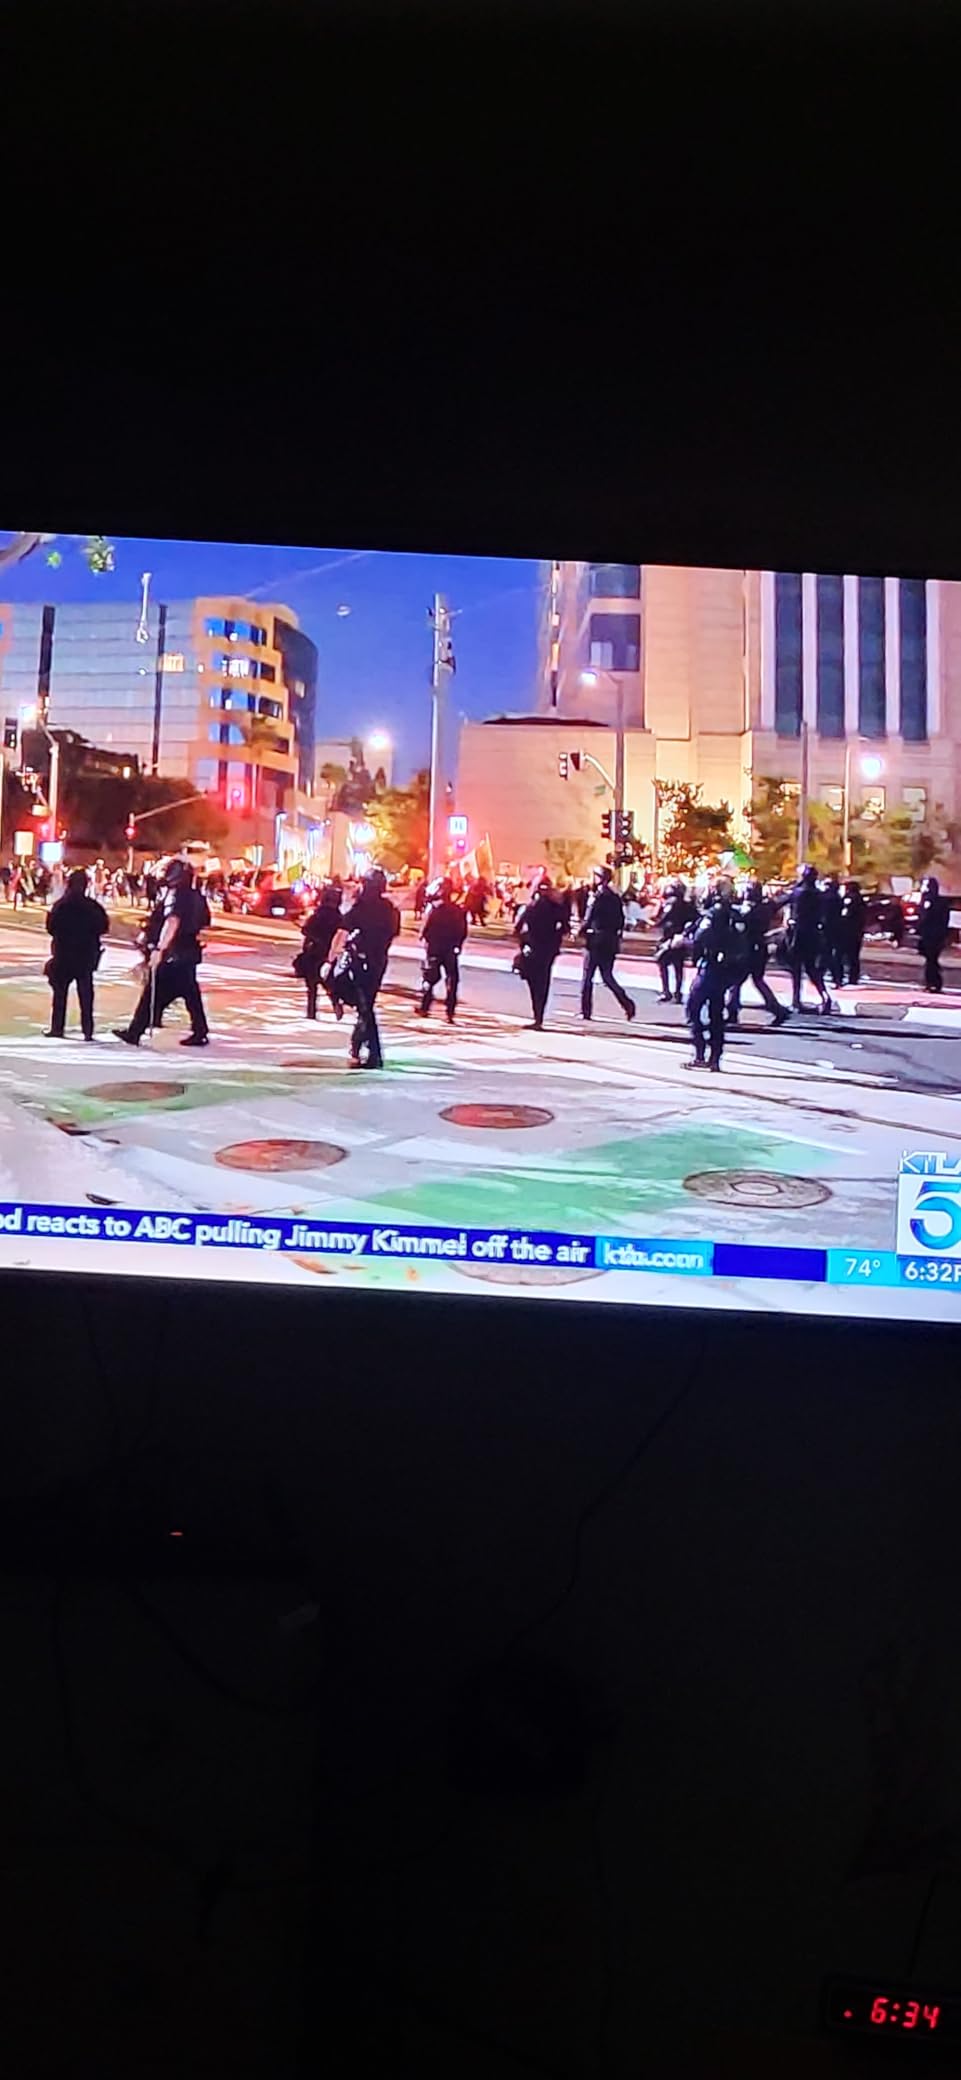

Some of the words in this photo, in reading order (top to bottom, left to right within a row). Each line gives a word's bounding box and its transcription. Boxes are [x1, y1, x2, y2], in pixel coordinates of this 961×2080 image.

[27, 1214, 100, 1235] reacts
[103, 1216, 131, 1238] to
[134, 1219, 191, 1240] ABC
[195, 1220, 281, 1249] pulling
[285, 1225, 368, 1255] Jimmy
[372, 1229, 467, 1256] Kimmel
[472, 1235, 508, 1258] off
[510, 1236, 552, 1261] the
[556, 1241, 591, 1264] air
[910, 1181, 961, 1250] 5
